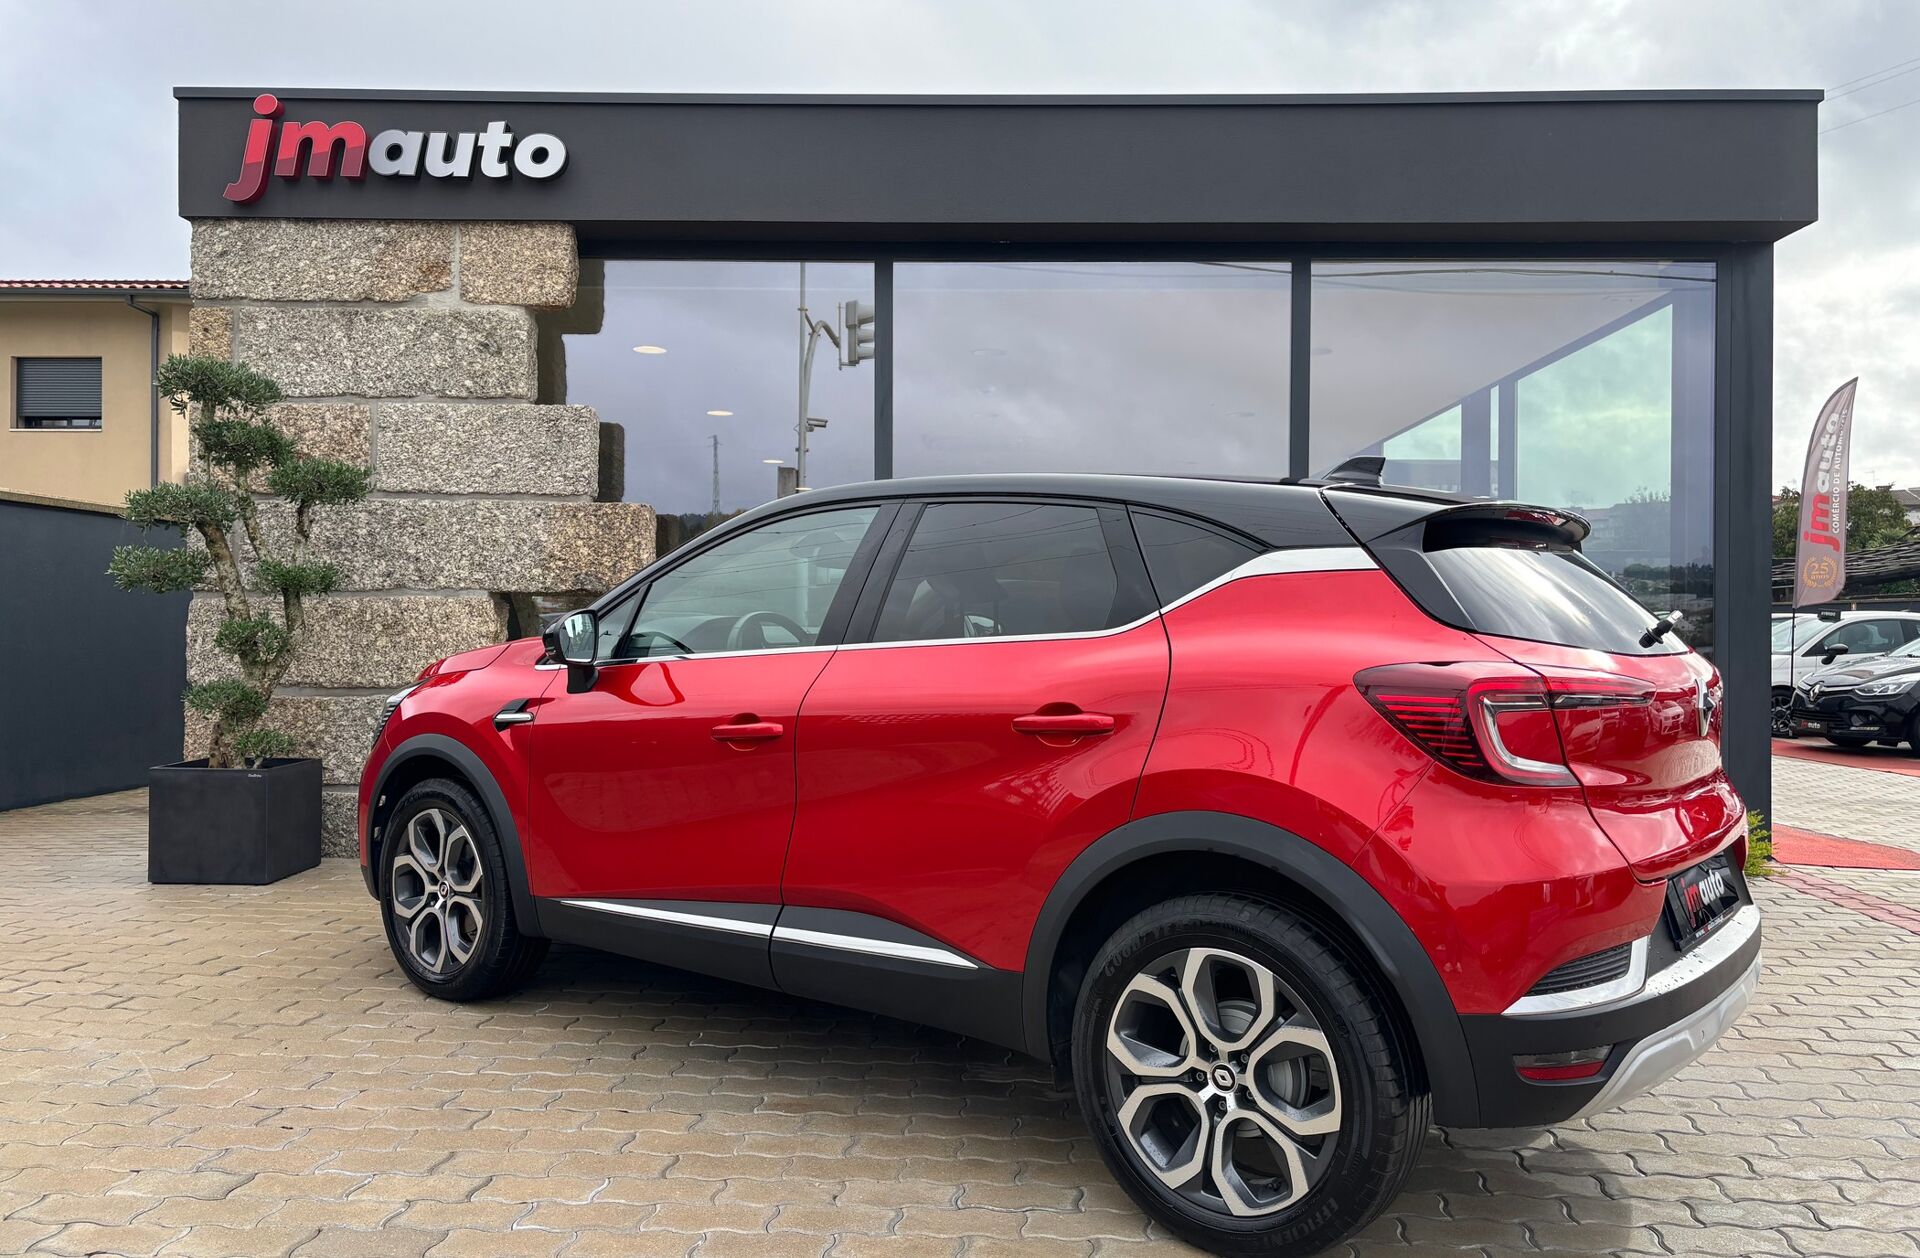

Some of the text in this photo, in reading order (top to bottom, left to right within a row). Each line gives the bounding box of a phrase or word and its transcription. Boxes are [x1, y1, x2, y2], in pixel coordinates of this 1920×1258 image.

[223, 94, 568, 204] jmauto
[1803, 413, 1840, 552] jmauto
[1833, 472, 1840, 483] DE
[1832, 487, 1840, 534] COMÉRCIO
[1810, 562, 1829, 575] 25
[1681, 869, 1724, 928] jmauto
